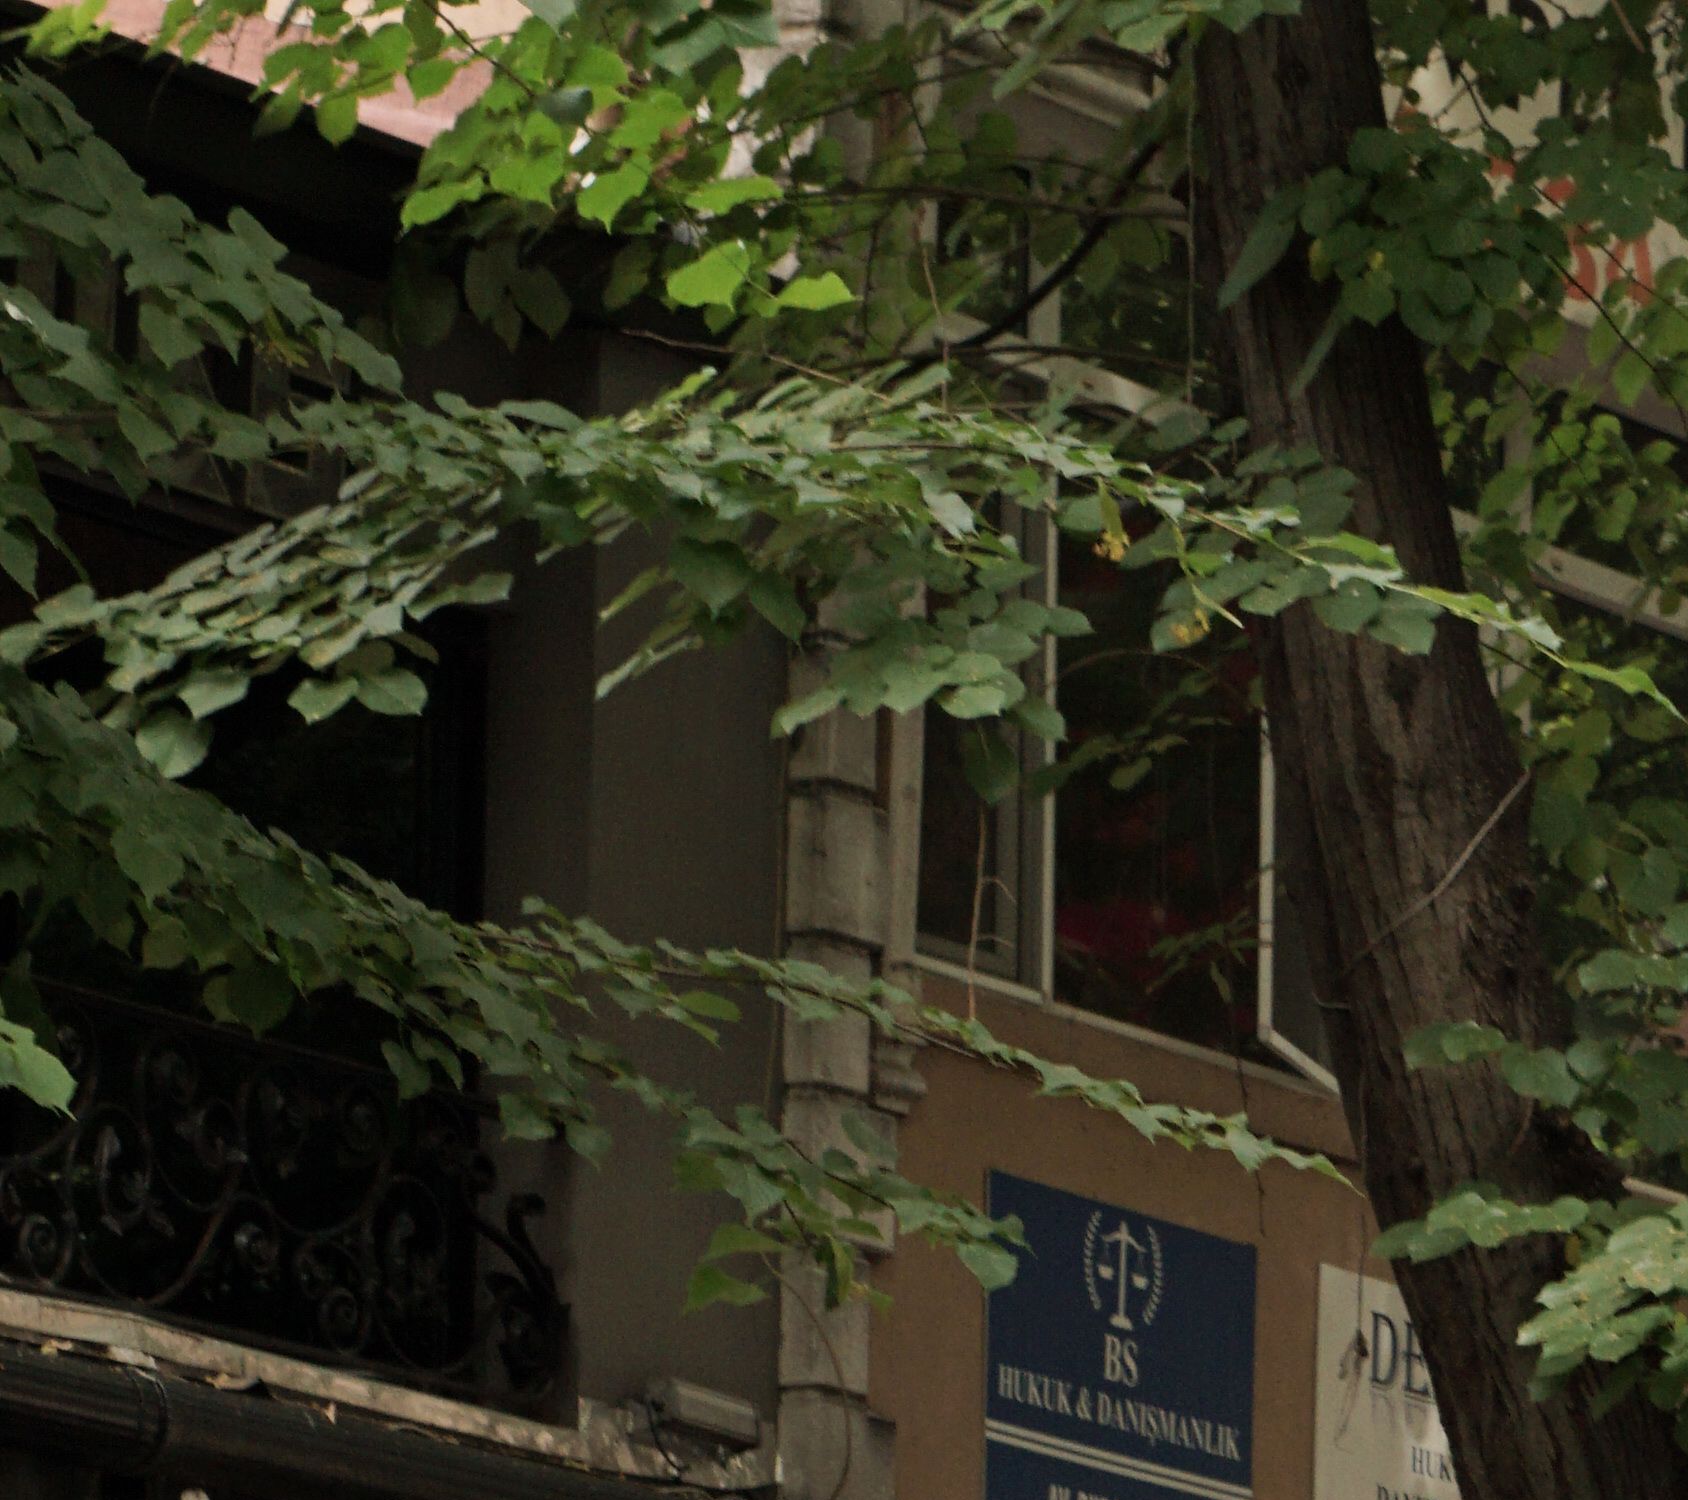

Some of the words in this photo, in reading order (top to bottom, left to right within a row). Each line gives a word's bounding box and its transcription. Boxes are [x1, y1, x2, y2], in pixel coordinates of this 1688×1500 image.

[1104, 1333, 1138, 1387] BS
[999, 1363, 1072, 1416] HUKUK
[1076, 1386, 1093, 1422] &
[1098, 1391, 1240, 1461] DANIŞMANLIK
